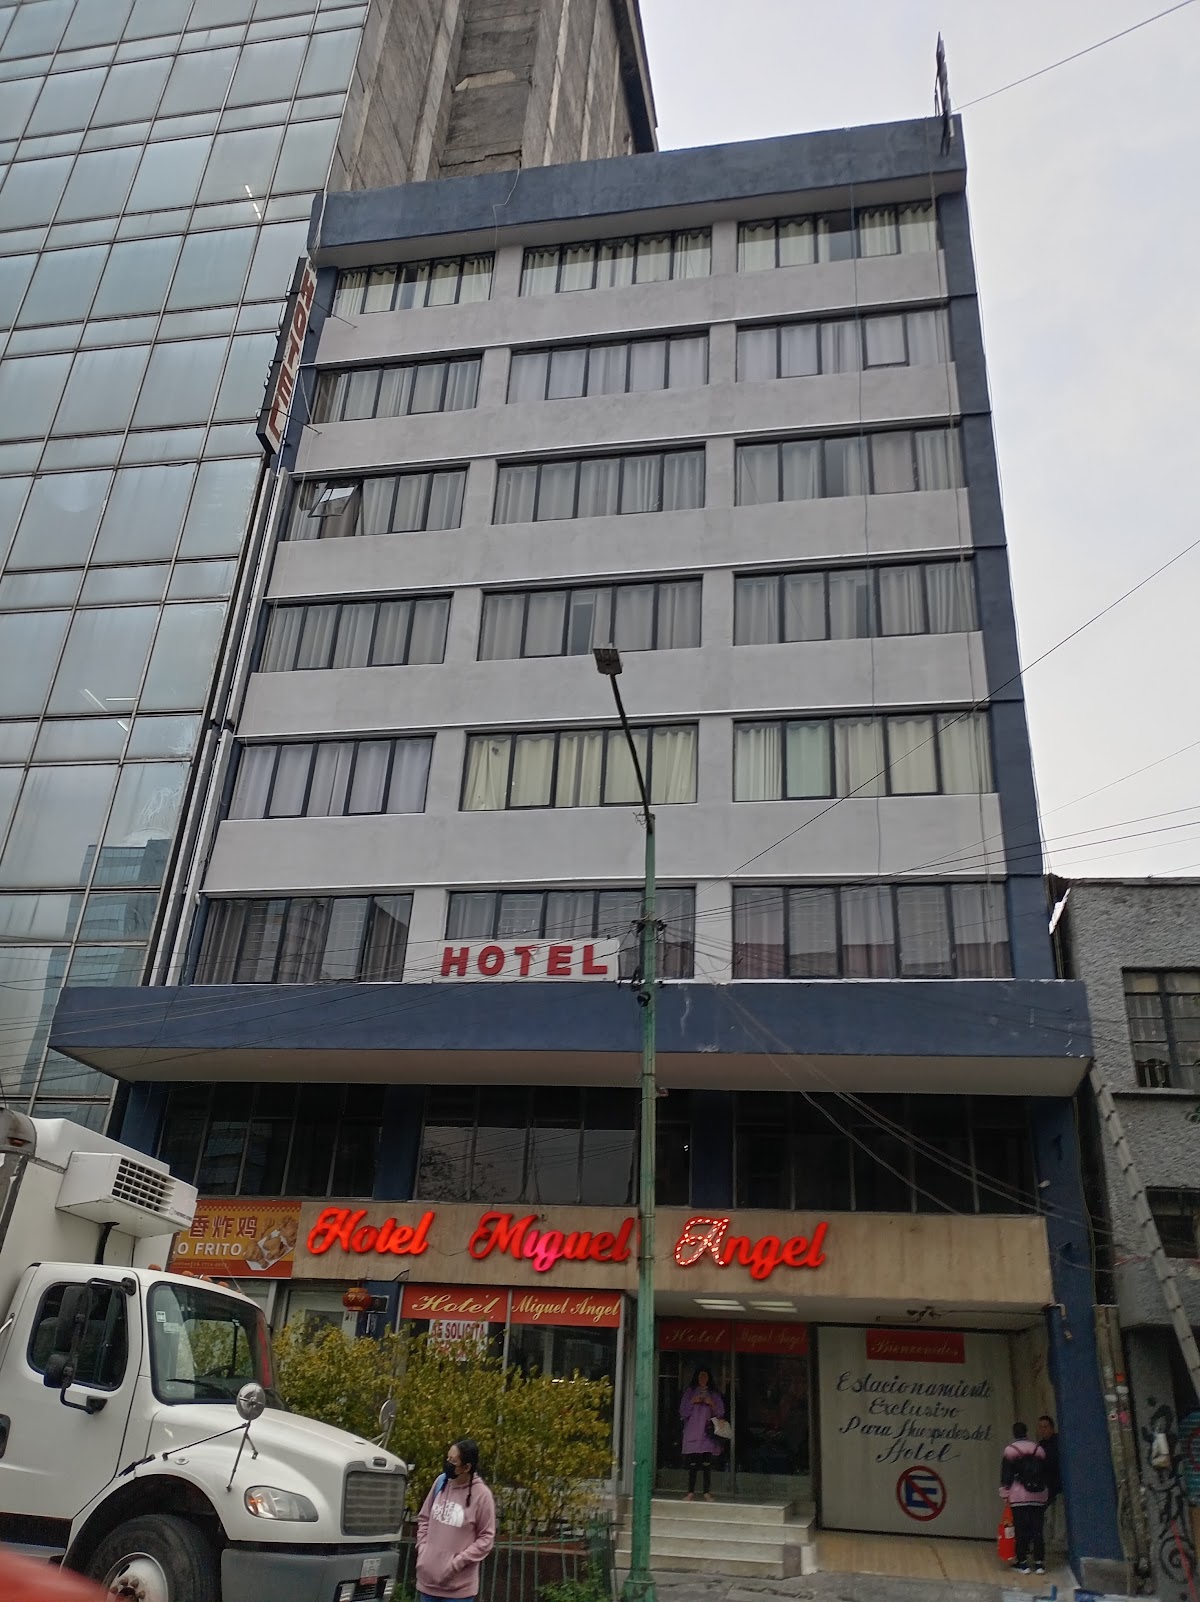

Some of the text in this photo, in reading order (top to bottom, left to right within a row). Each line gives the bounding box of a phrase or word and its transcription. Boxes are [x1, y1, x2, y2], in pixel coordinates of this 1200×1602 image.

[440, 945, 608, 977] HOTEL
[173, 1215, 258, 1239] 香炸鸡
[194, 1242, 243, 1257] FRITO
[306, 1206, 829, 1280] Hotel Miguel Angel
[411, 1294, 501, 1315] Hotel
[511, 1296, 568, 1321] Miguel
[665, 1327, 726, 1344] Hotel
[836, 1371, 994, 1399] Estacionamiento
[868, 1396, 964, 1419] Exclusivo
[839, 1415, 893, 1435] Para
[875, 1439, 961, 1465] Hotel
